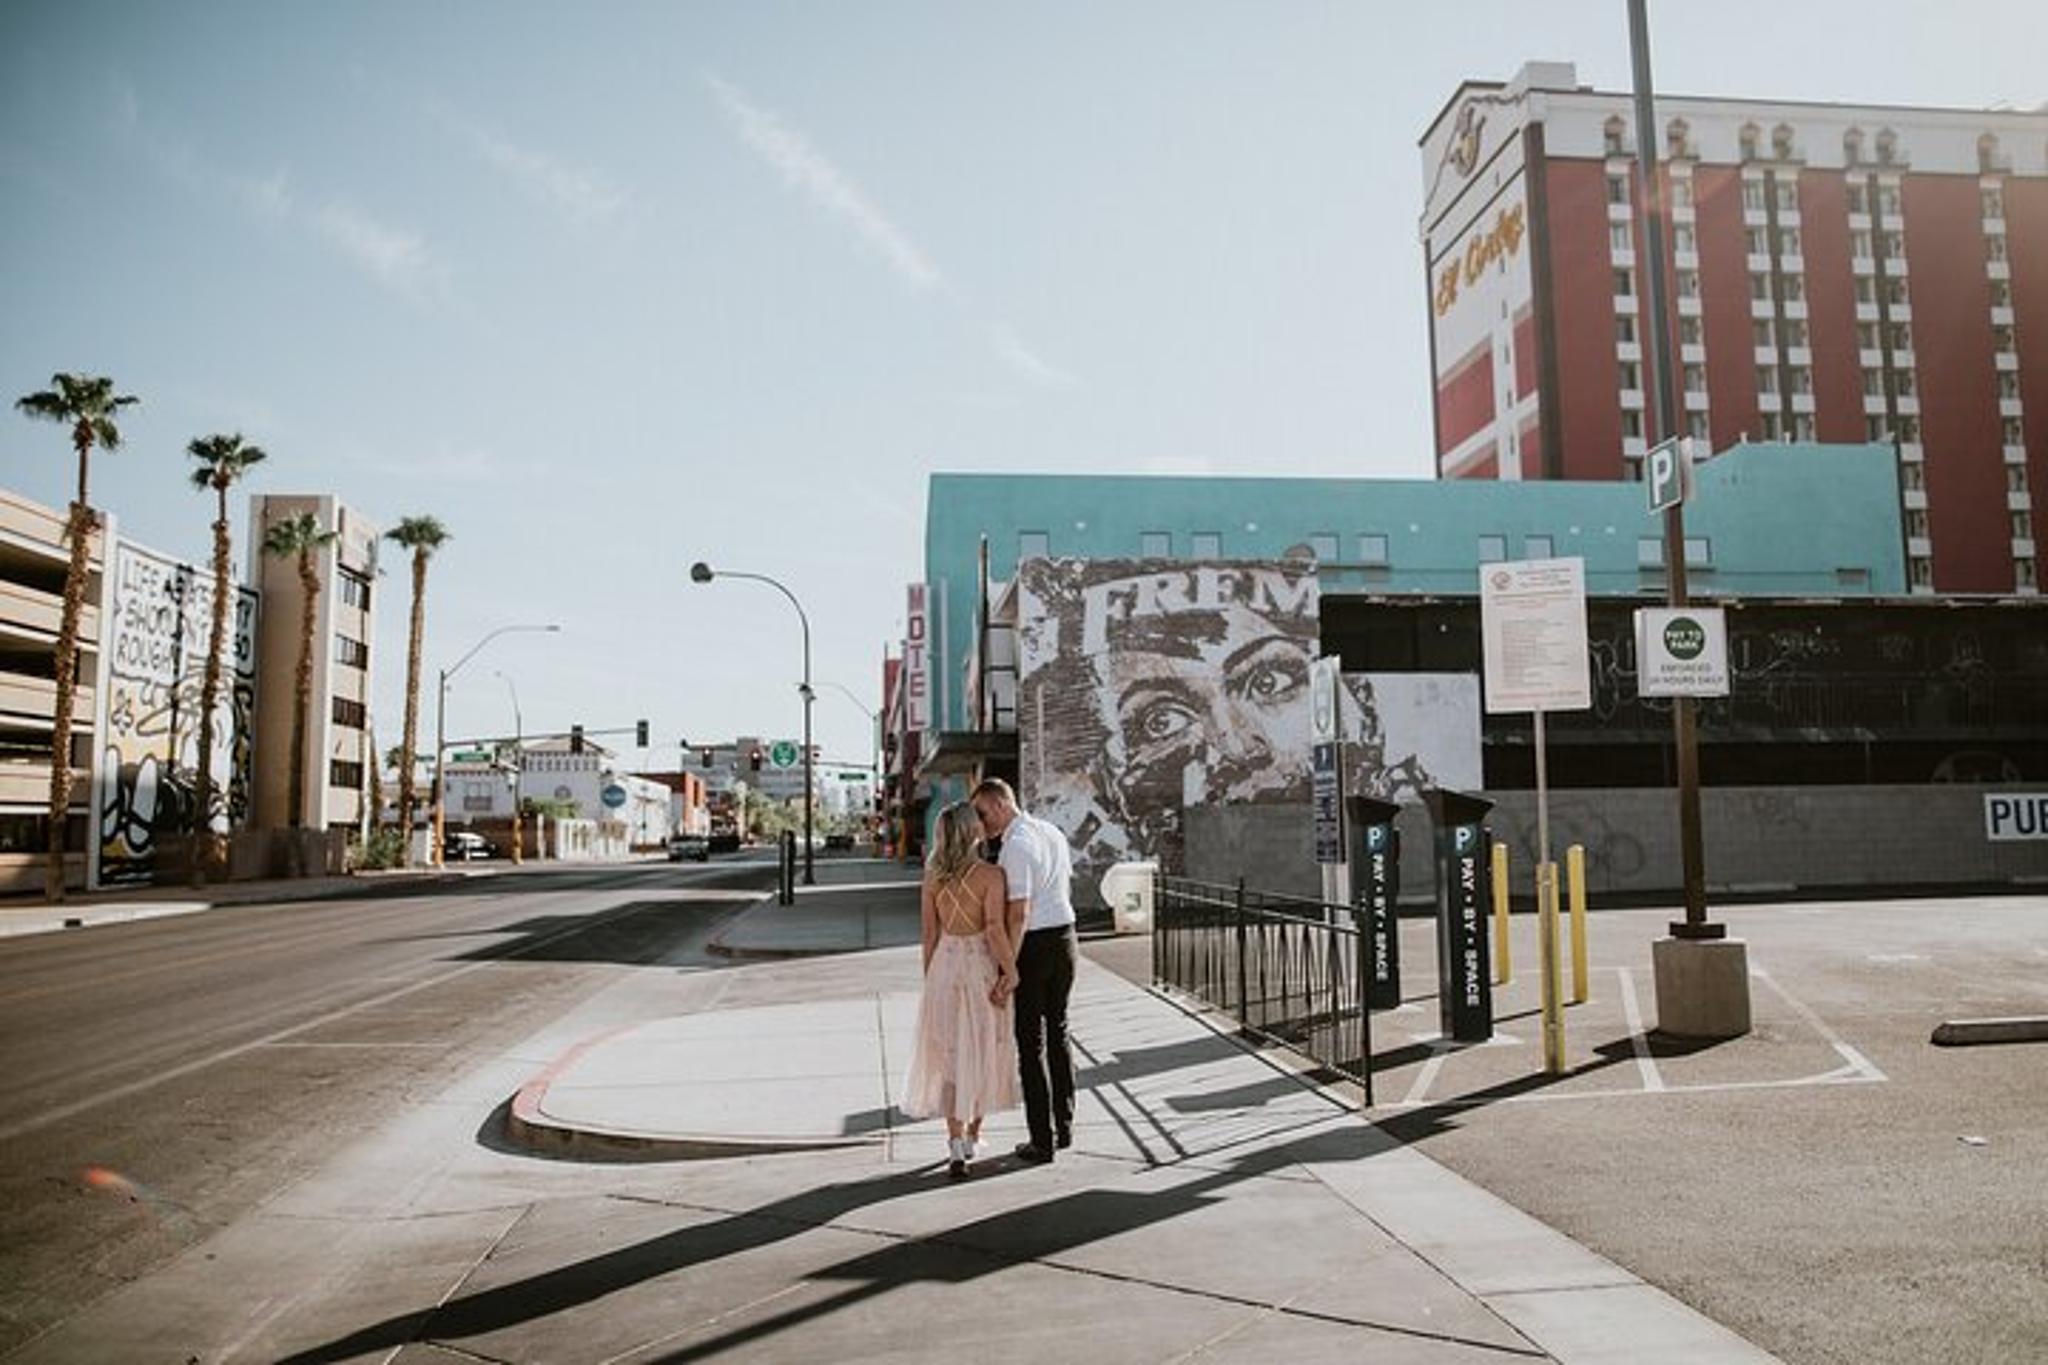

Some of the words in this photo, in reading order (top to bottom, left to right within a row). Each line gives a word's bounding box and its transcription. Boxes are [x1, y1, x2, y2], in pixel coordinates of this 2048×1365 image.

[1652, 449, 1673, 505] P
[909, 584, 926, 727] MOTEL
[1670, 640, 1699, 650] PARK
[1372, 853, 1385, 883] PAY
[1461, 858, 1475, 891] PAY
[1463, 907, 1477, 933] BY
[1375, 931, 1389, 983] SPACE
[1464, 949, 1480, 1007] SPACE
